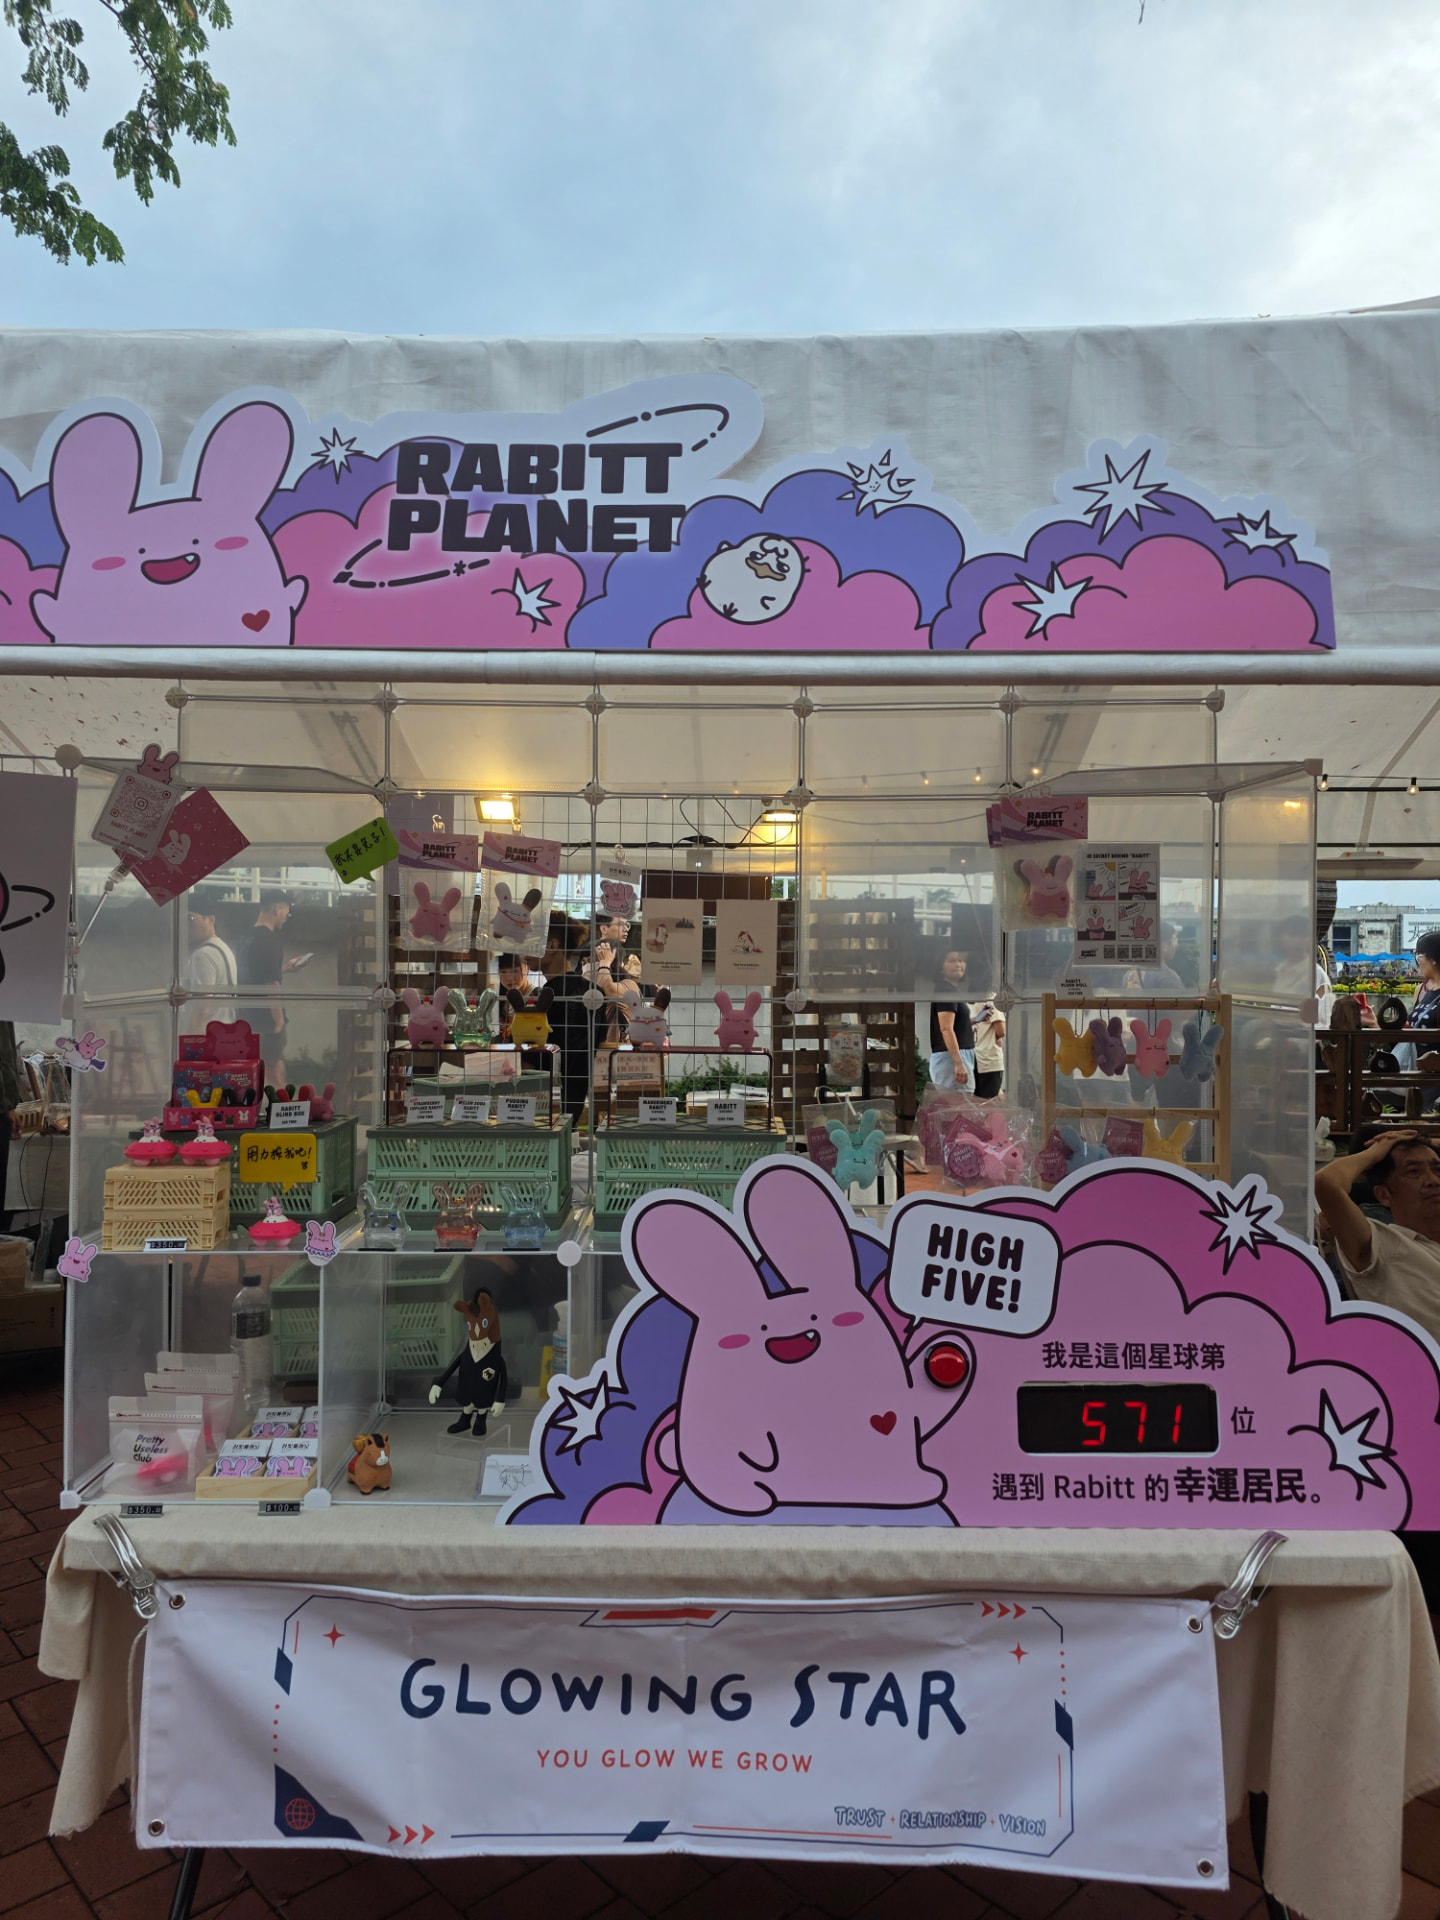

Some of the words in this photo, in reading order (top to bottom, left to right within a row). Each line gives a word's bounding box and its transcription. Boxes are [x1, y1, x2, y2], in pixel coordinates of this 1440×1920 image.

[396, 442, 683, 494] RABITT
[387, 498, 686, 552] PLANET
[1026, 818, 1064, 827] PLANET
[1027, 811, 1063, 819] RABITT
[422, 843, 456, 852] RABITT
[422, 851, 457, 859] PLANET
[504, 854, 538, 864] PLANET
[505, 846, 539, 857] RABITT
[927, 1223, 1024, 1272] HIGH
[921, 1263, 1021, 1313] FIVE!
[1042, 1341, 1225, 1370] 我是這個星球第
[1081, 1401, 1182, 1446] 571
[1230, 1406, 1256, 1434] 位
[133, 1444, 169, 1454] Useless
[135, 1434, 166, 1446] Pretty
[133, 1453, 152, 1463] Club
[992, 1472, 1044, 1501] 遇到
[1053, 1473, 1135, 1499] Rabitt
[400, 1658, 752, 1722] GLOWING
[789, 1664, 967, 1740] STAR
[536, 1749, 589, 1769] YOU
[600, 1749, 675, 1769] GLOW
[687, 1750, 724, 1769] WE
[736, 1752, 813, 1774] GROW
[834, 1806, 886, 1828] TRUST
[899, 1809, 987, 1830] RELATIONSHIP
[999, 1812, 1046, 1837] VISION
